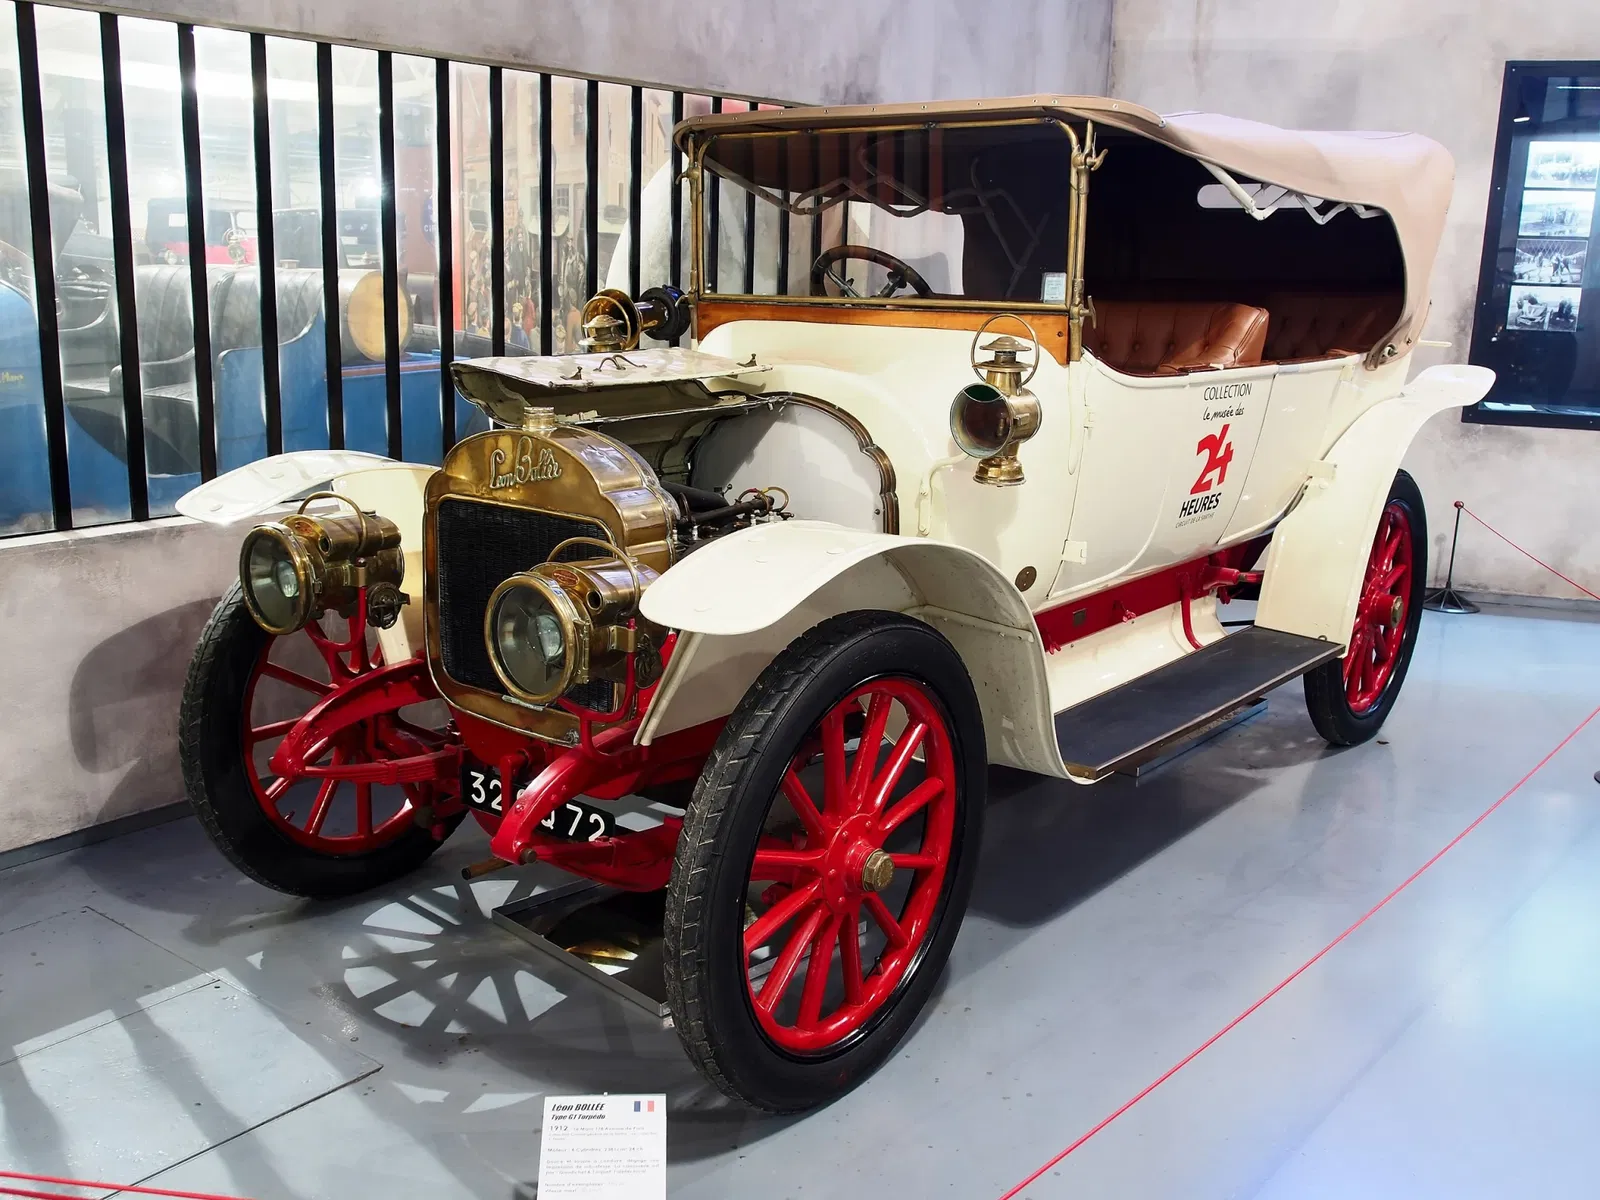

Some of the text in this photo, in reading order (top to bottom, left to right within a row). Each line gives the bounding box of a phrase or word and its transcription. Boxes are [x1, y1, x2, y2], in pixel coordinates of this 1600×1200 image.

[1203, 382, 1252, 401] COLLECTION
[1210, 405, 1234, 421] musée
[1235, 402, 1245, 416] des
[1189, 423, 1235, 496] 24
[1178, 492, 1222, 519] HEURES
[574, 1102, 606, 1111] BOLLÉE
